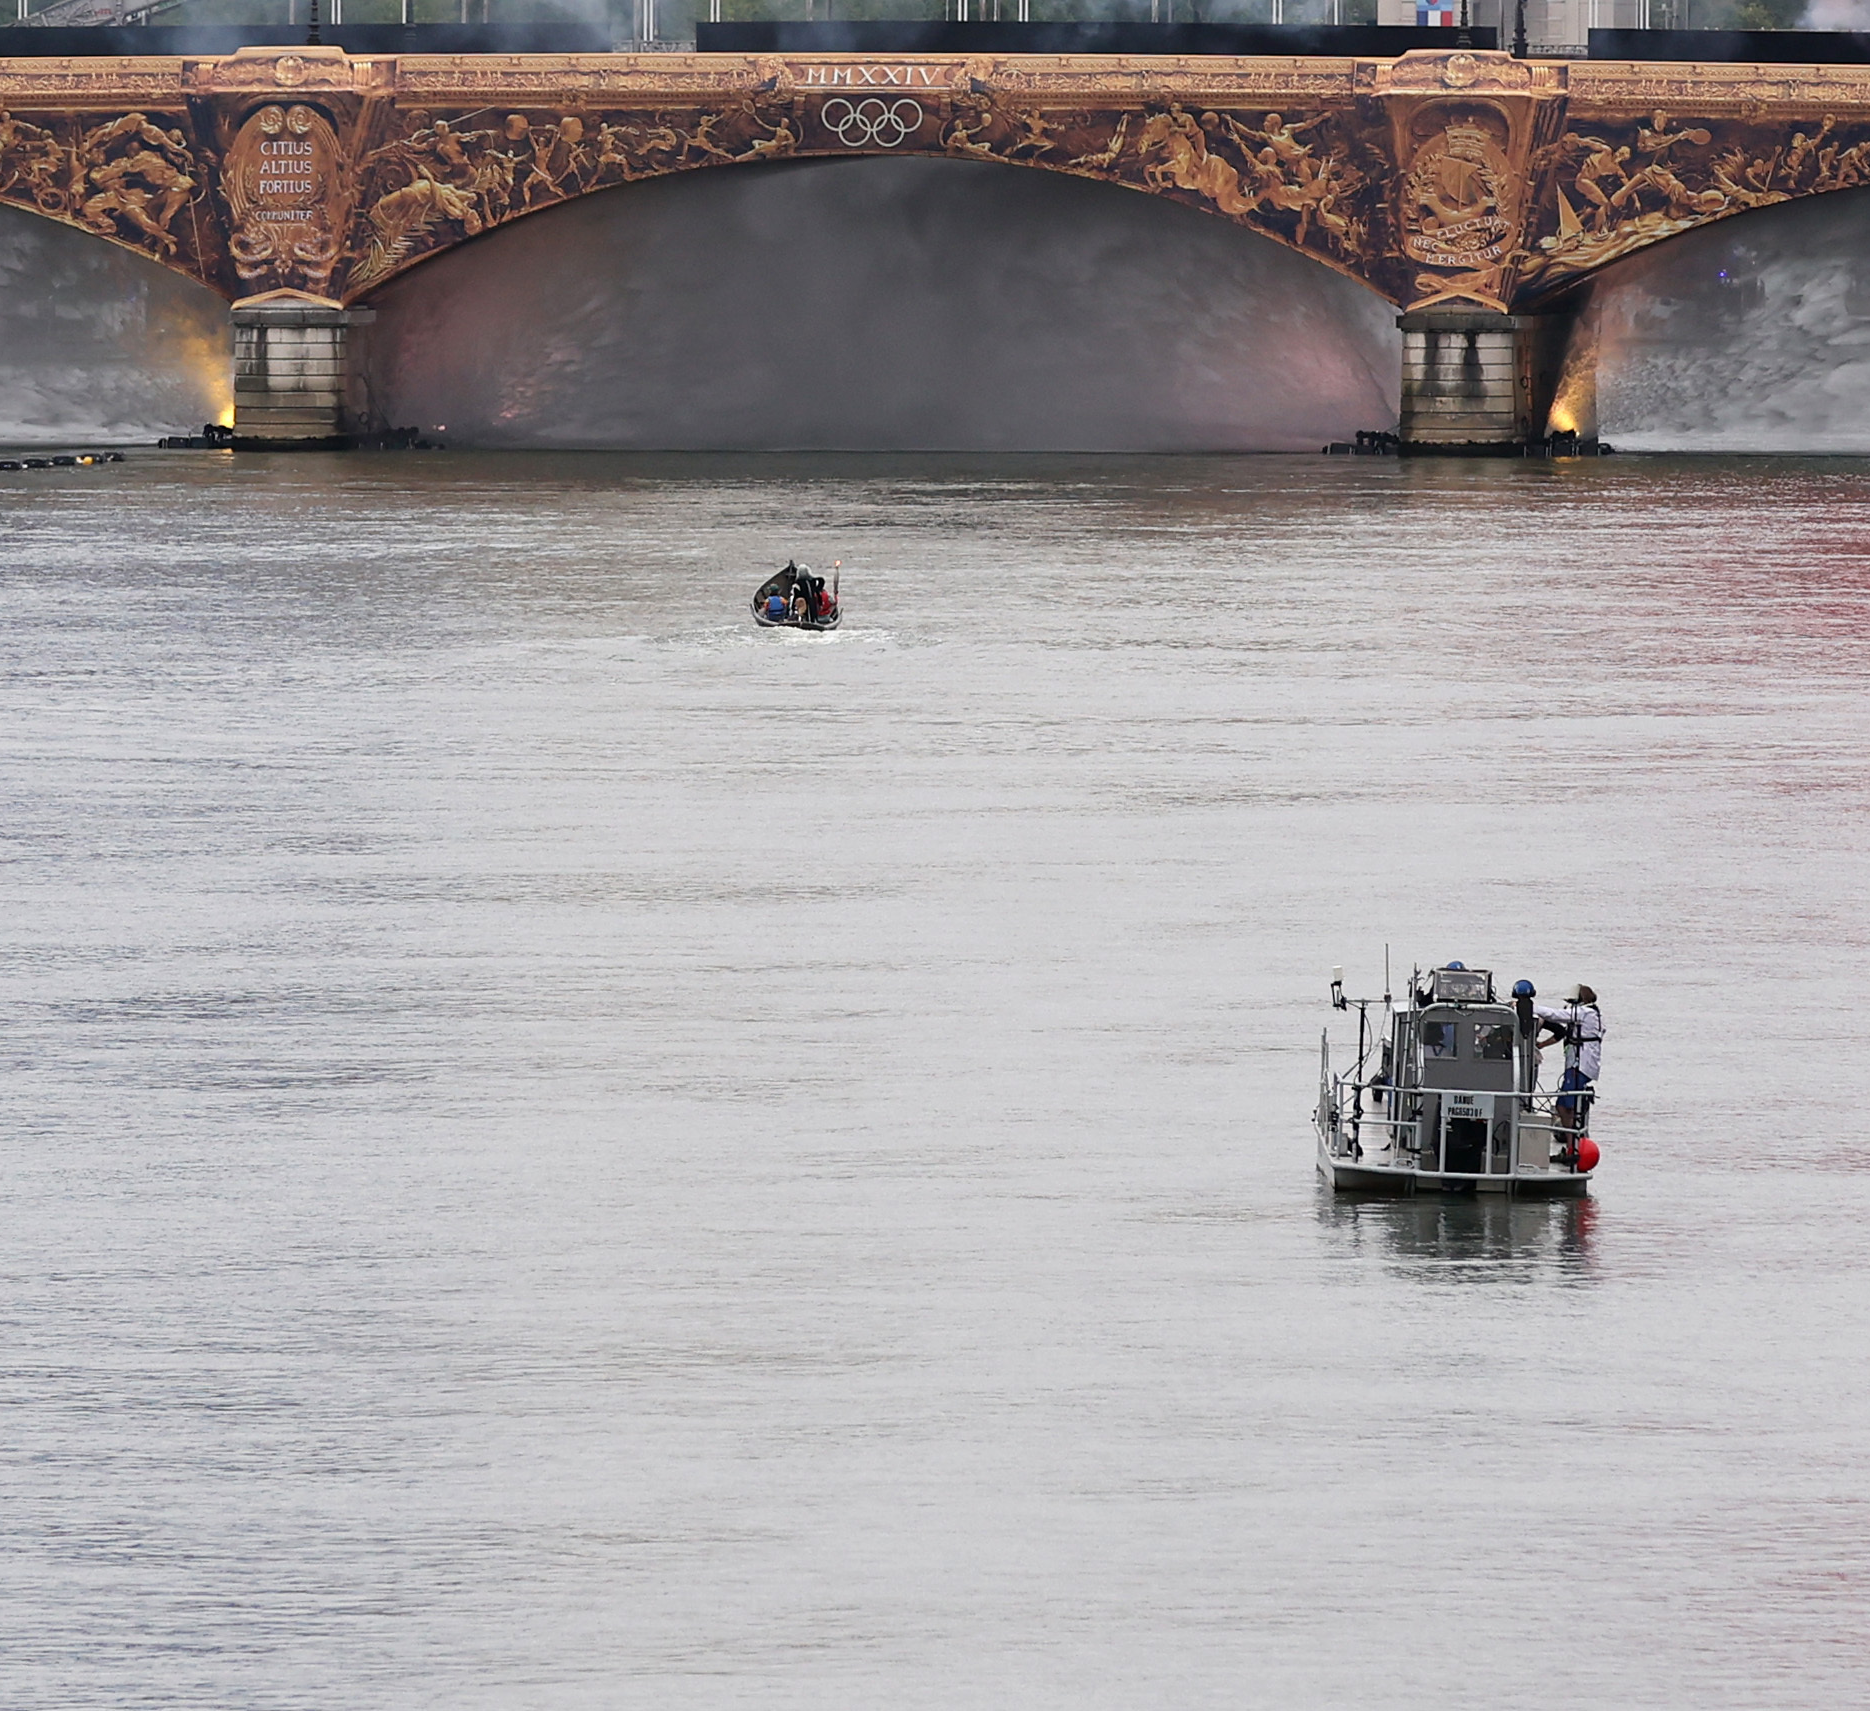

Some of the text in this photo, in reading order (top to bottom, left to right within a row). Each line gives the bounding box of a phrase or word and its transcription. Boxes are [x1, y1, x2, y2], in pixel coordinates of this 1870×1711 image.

[805, 66, 941, 85] MMXXIV
[260, 141, 312, 155] CITIUS
[259, 160, 312, 174] ALTIUS
[259, 180, 312, 194] FORTIUS
[255, 210, 313, 222] COMMUNITER
[1436, 215, 1511, 239] FLUCTUAT
[1413, 238, 1438, 251] NEC
[1425, 245, 1502, 264] MERGITUR
